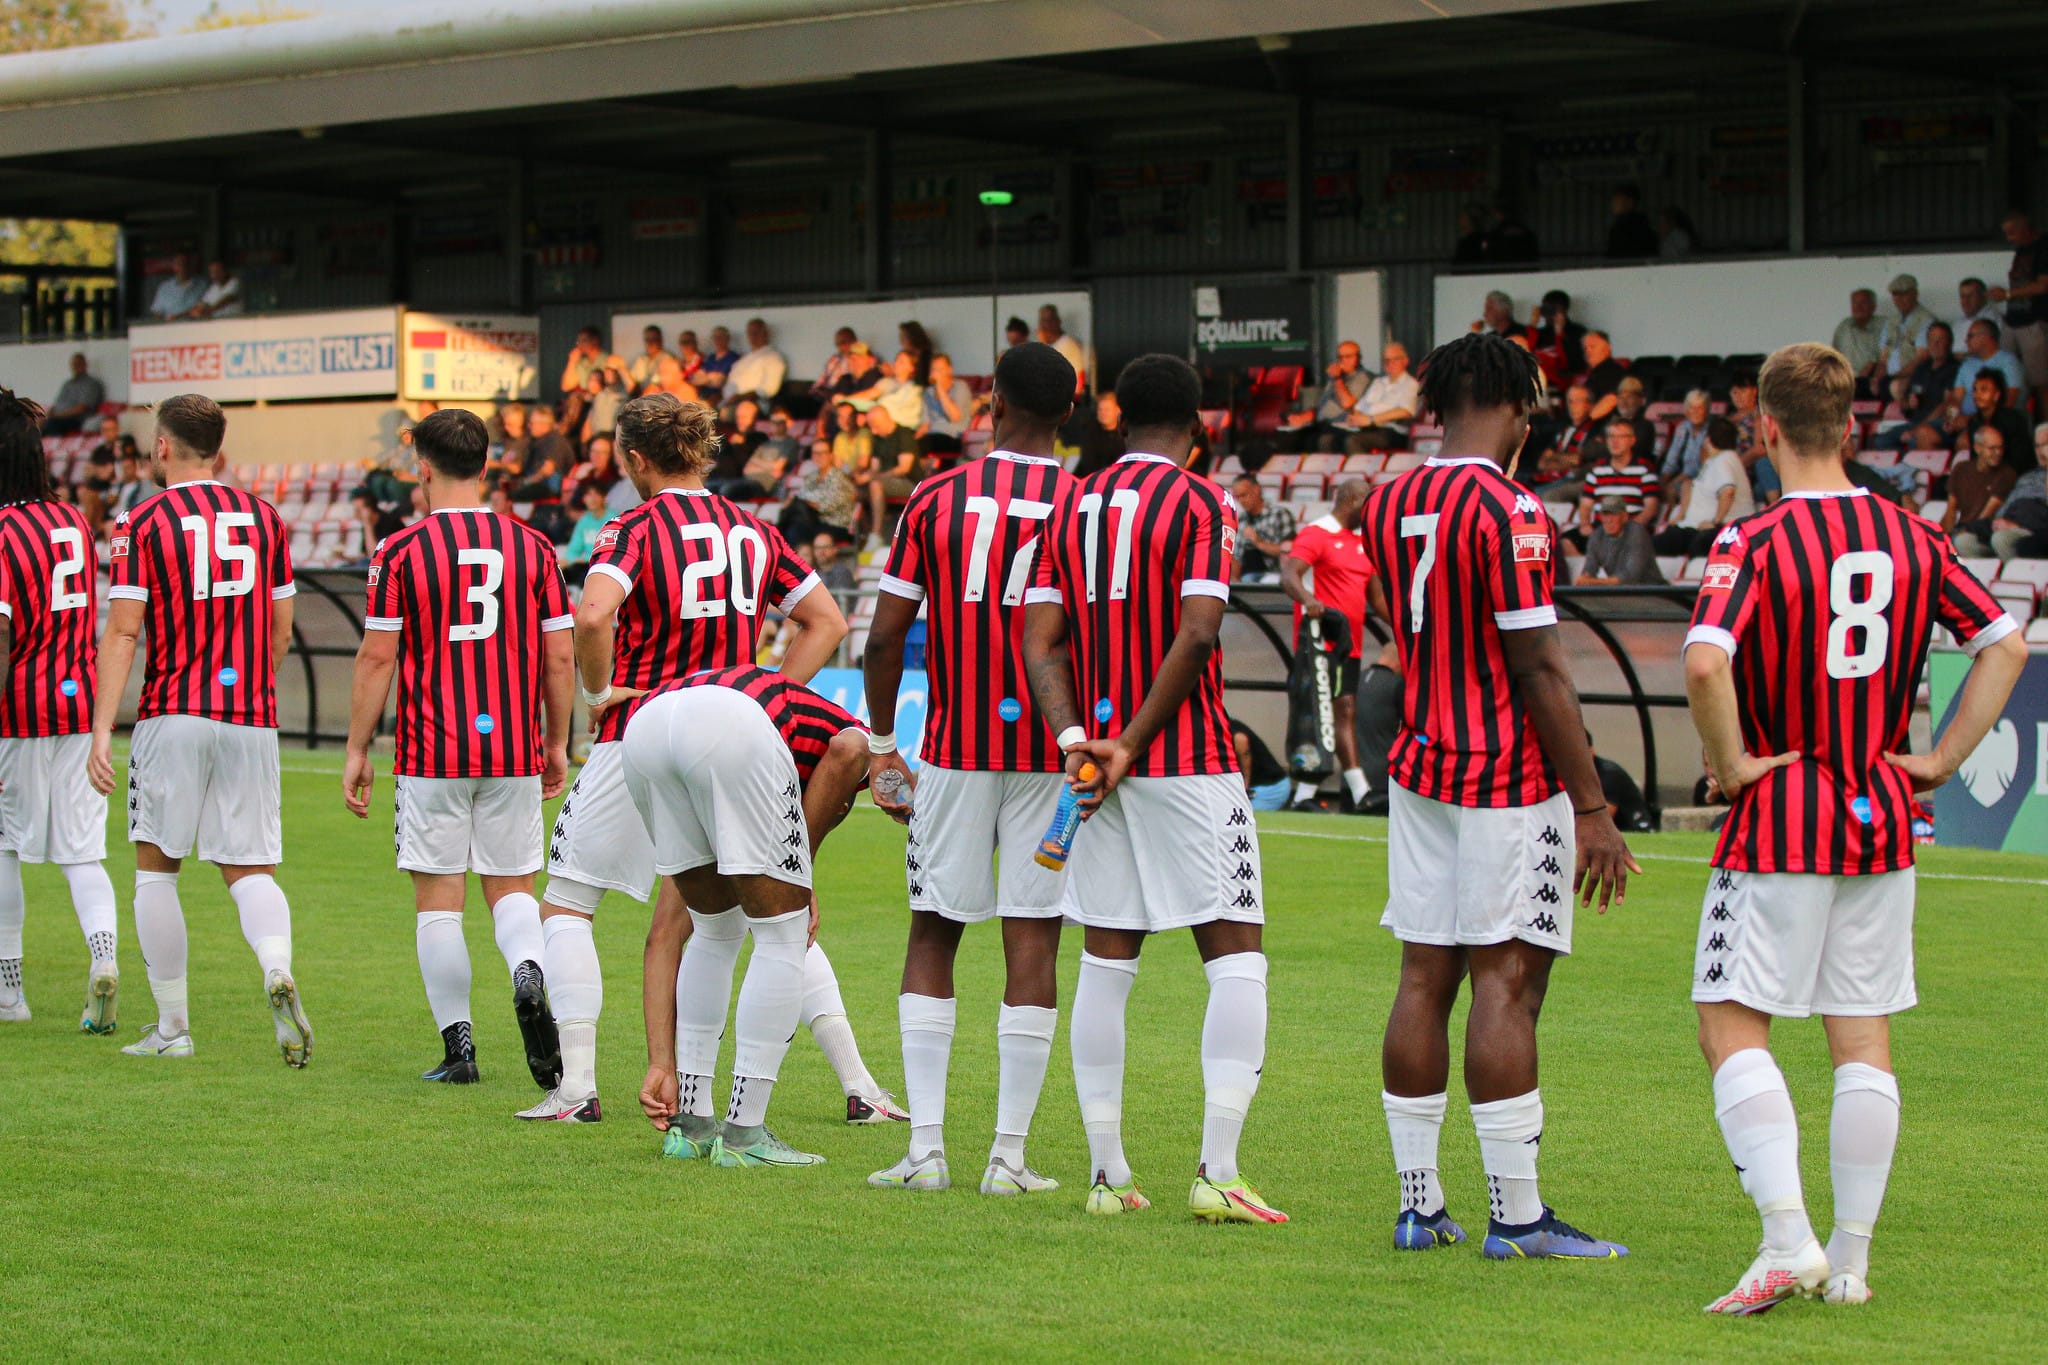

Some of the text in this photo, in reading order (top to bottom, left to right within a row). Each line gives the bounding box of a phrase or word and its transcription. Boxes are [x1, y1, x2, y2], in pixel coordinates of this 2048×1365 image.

[132, 336, 393, 382] TEENAGE CANCER TRUST
[50, 526, 88, 612] 2
[181, 511, 256, 600] 15
[448, 549, 504, 642] 3
[680, 522, 768, 620] 20
[964, 496, 1054, 607] 17
[1078, 489, 1139, 604] 11
[1400, 513, 1440, 633] 7
[1826, 550, 1894, 679] 8
